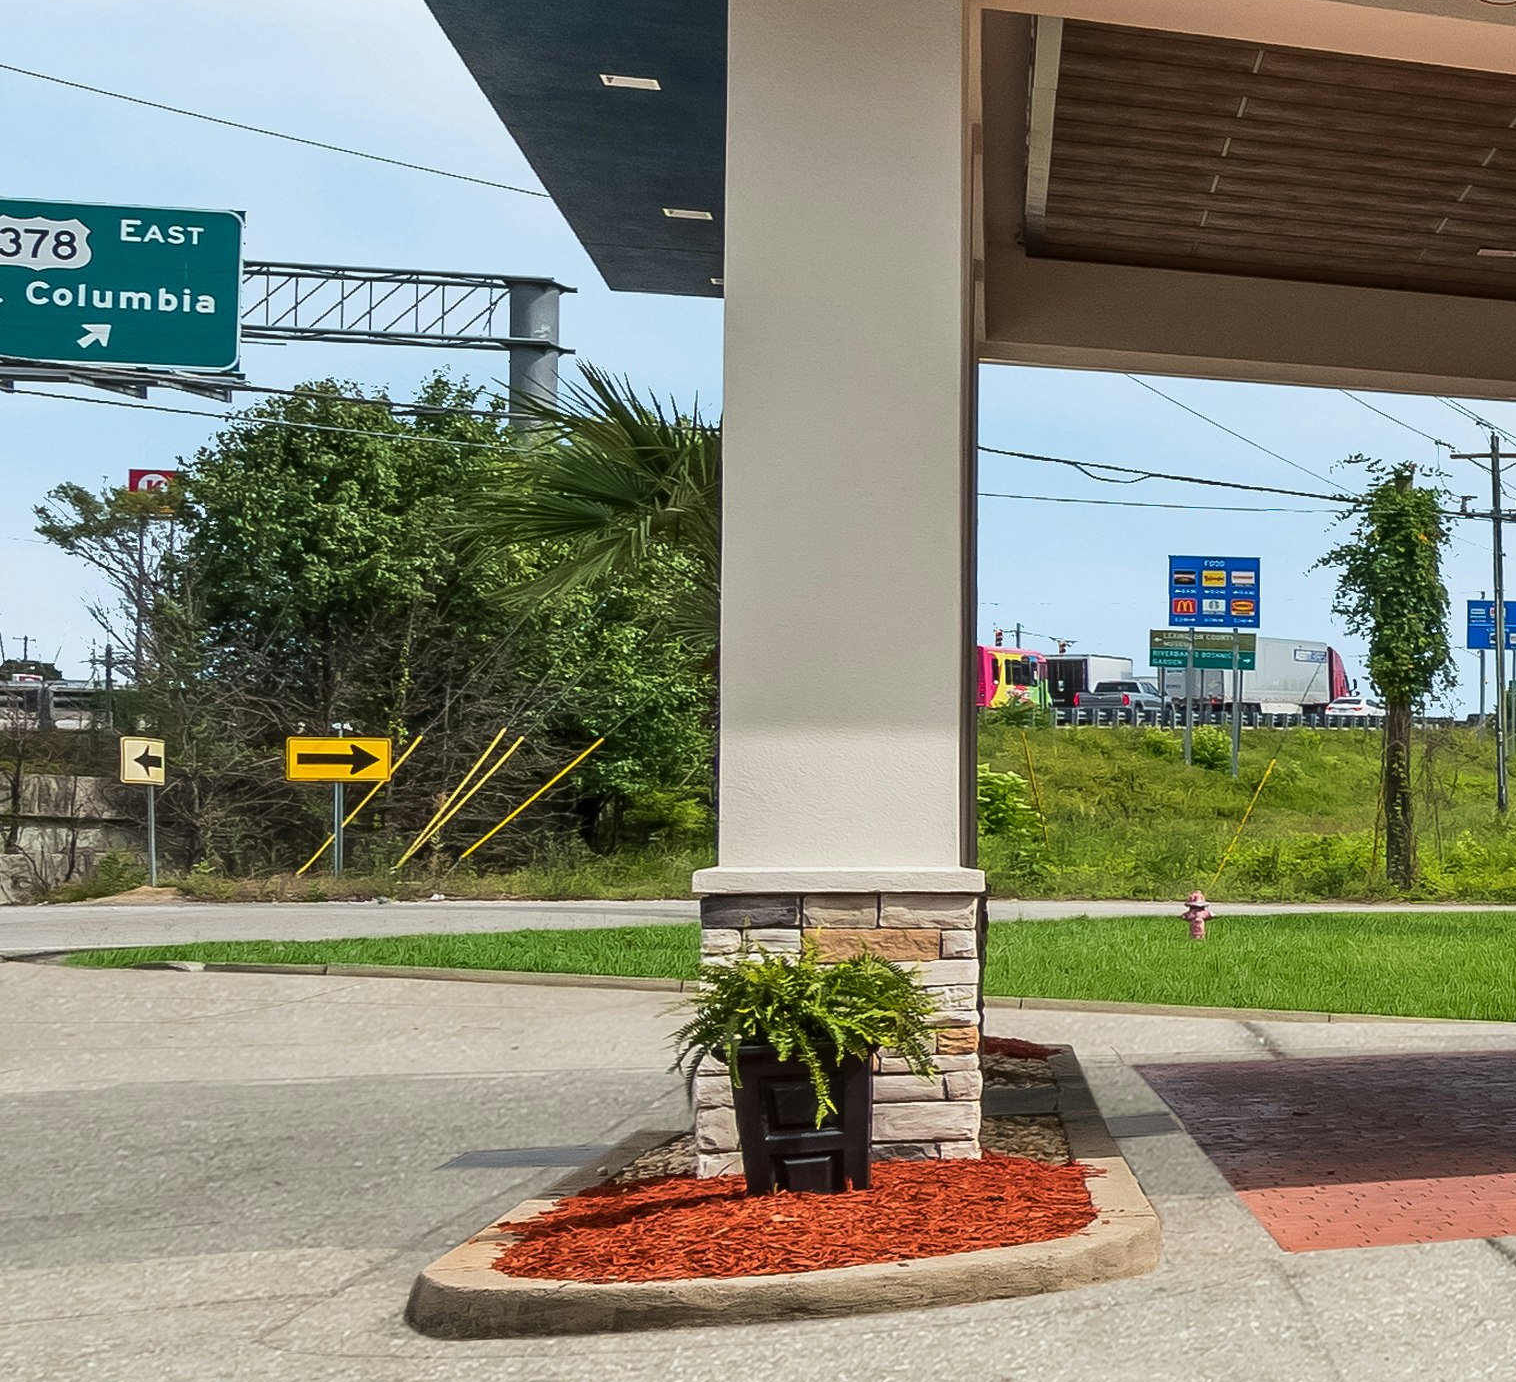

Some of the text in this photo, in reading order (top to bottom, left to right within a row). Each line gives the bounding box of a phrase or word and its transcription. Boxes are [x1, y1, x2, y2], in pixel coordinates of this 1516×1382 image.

[0, 219, 205, 261] 378 EAST
[26, 280, 216, 314] Columbia
[1163, 632, 1204, 640] LEXINGON
